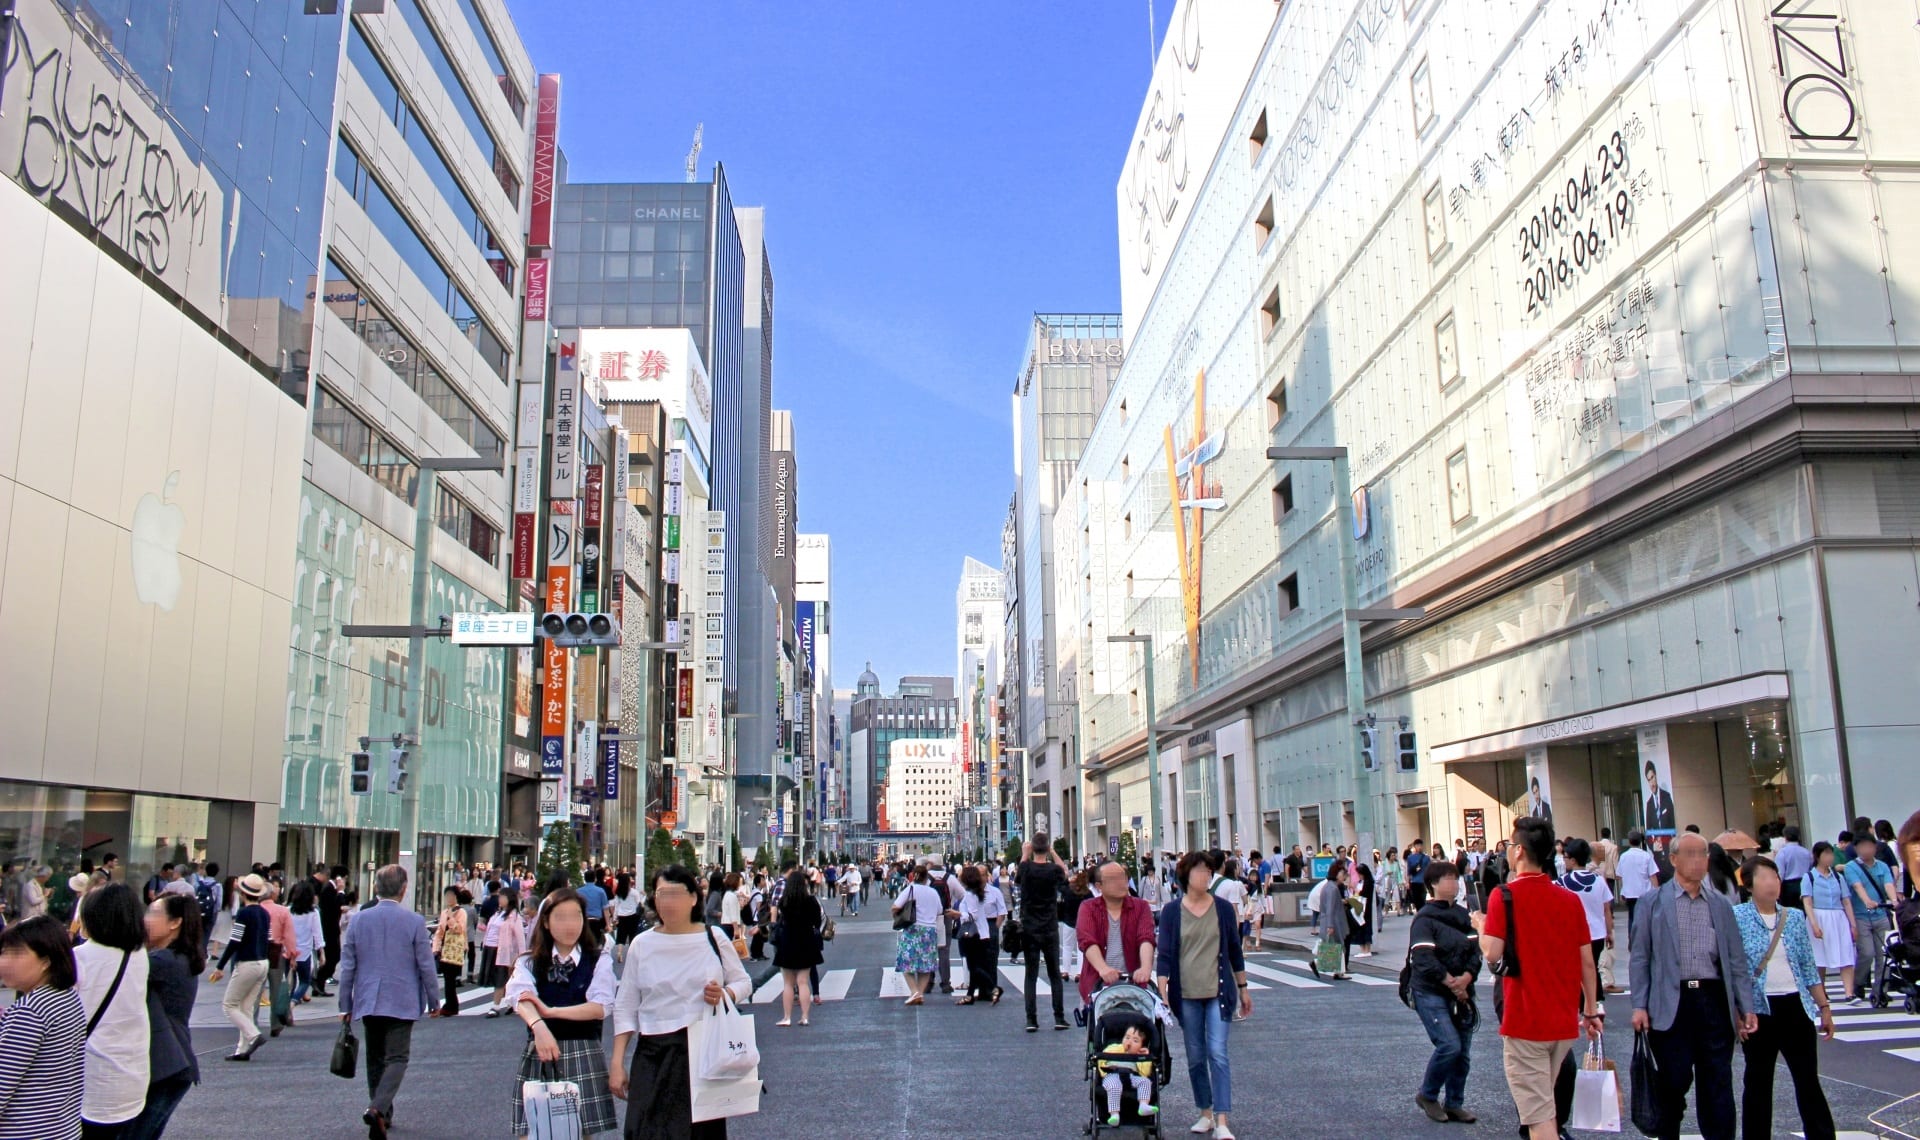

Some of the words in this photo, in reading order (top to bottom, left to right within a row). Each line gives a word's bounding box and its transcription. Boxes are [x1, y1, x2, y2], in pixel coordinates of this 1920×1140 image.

[534, 131, 555, 207] TAMAYA
[635, 207, 702, 219] CHANEL
[1519, 131, 1624, 262] 2016.04.23
[1524, 190, 1629, 313] 2016.06.19
[527, 262, 545, 318] プレミア証券
[599, 350, 669, 382] 証券
[556, 387, 573, 481] 日本香堂ビル
[1572, 394, 1614, 441] 入場無料
[775, 457, 789, 491] Zegna
[775, 491, 789, 559] Ermenegildo
[458, 620, 528, 633] 銀座三丁目
[708, 702, 717, 737] 大和証券
[904, 743, 945, 758] LIXIL
